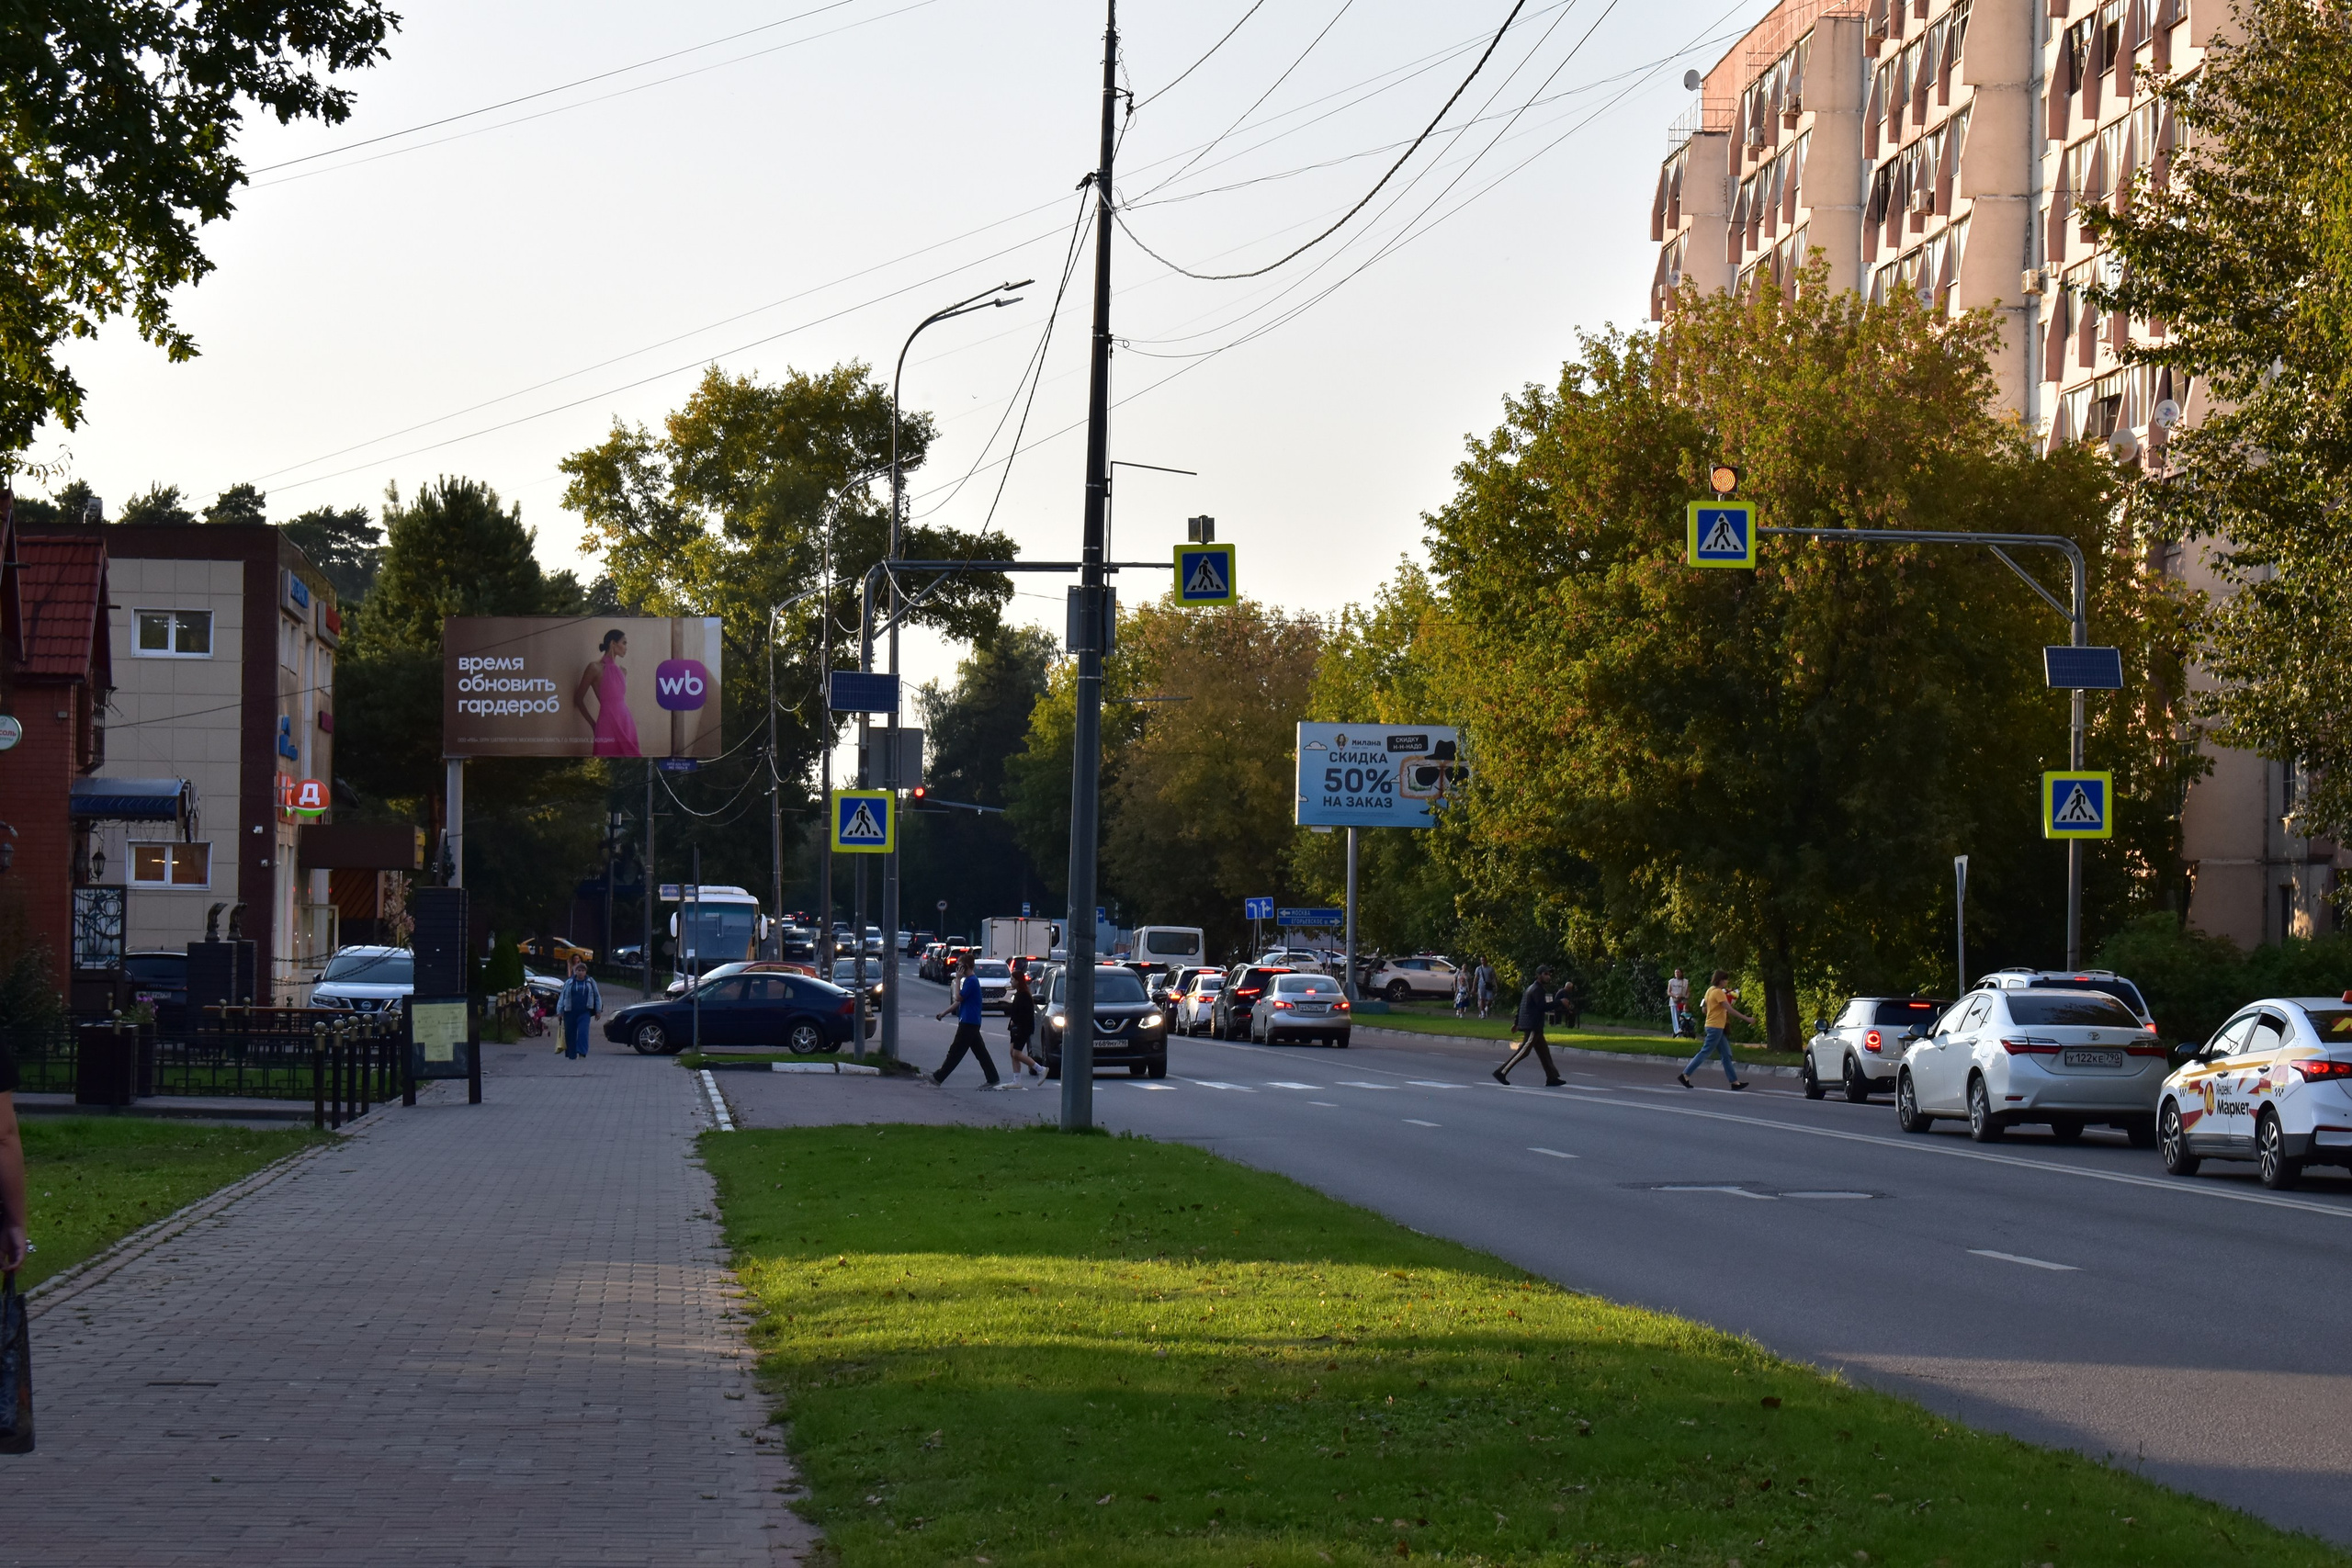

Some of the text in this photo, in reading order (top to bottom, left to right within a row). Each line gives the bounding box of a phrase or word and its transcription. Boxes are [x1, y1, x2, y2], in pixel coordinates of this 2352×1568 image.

[458, 657, 524, 674] время
[458, 674, 556, 693] обновить
[659, 670, 704, 696] wb
[458, 695, 560, 716] гардероб
[1329, 752, 1388, 765] СКИДКА
[1324, 768, 1393, 794] 50%
[299, 783, 321, 806] Д
[1323, 796, 1393, 808] НА ЗАКАЗ
[2215, 1083, 2233, 1096] Яндекс
[2216, 1099, 2250, 1118] Маркет
